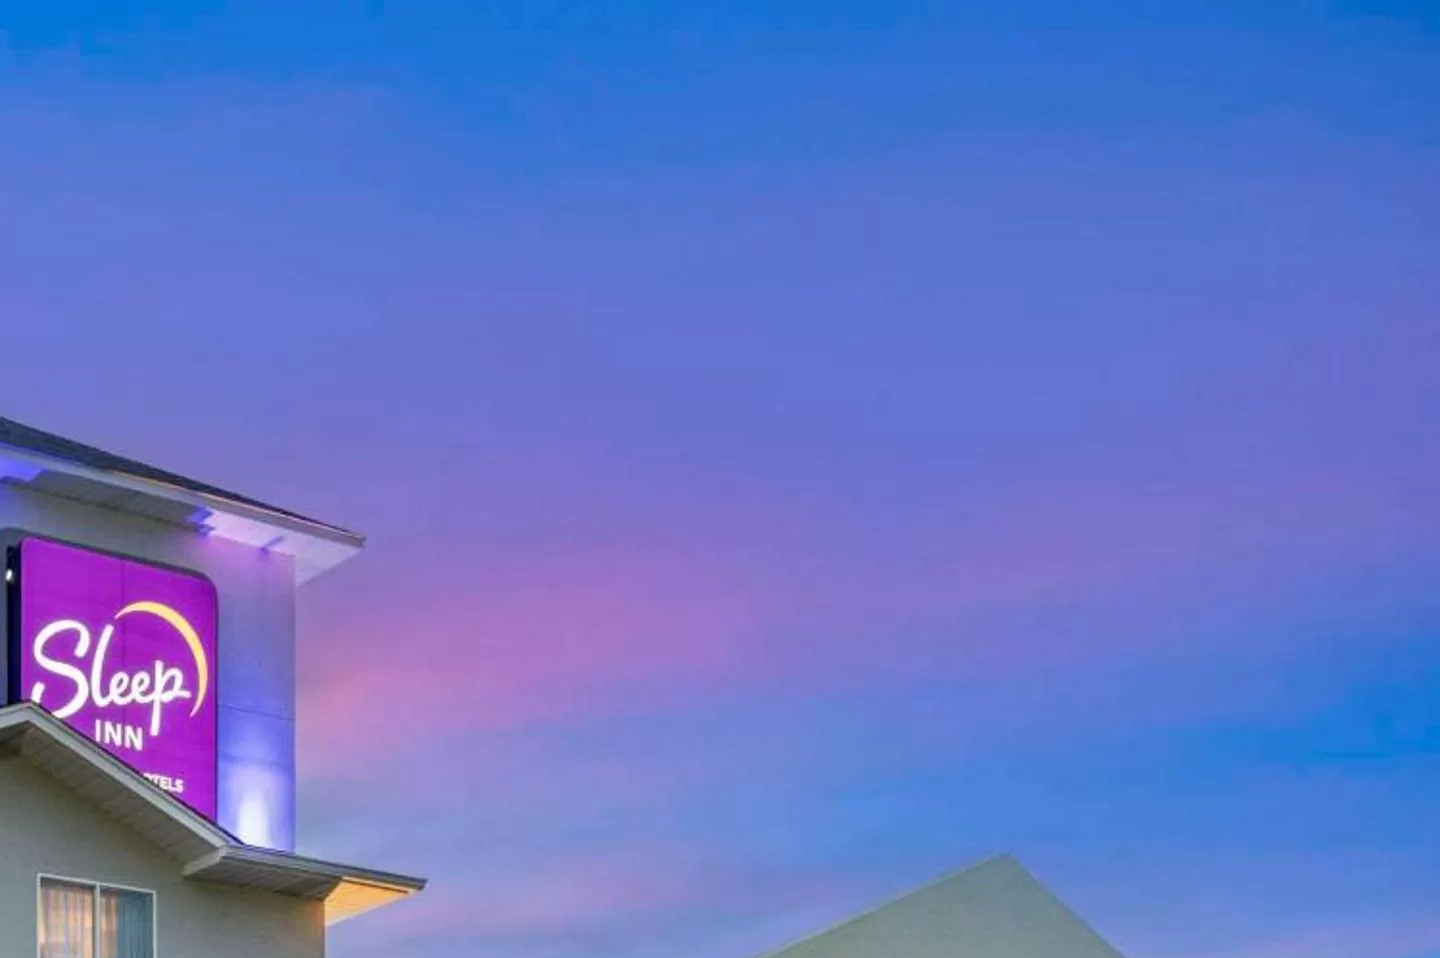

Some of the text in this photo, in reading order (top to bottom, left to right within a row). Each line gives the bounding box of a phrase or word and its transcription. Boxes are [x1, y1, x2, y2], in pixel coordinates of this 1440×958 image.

[30, 619, 192, 737] Sleep
[95, 719, 144, 750] INN
[143, 772, 184, 793] TELS
